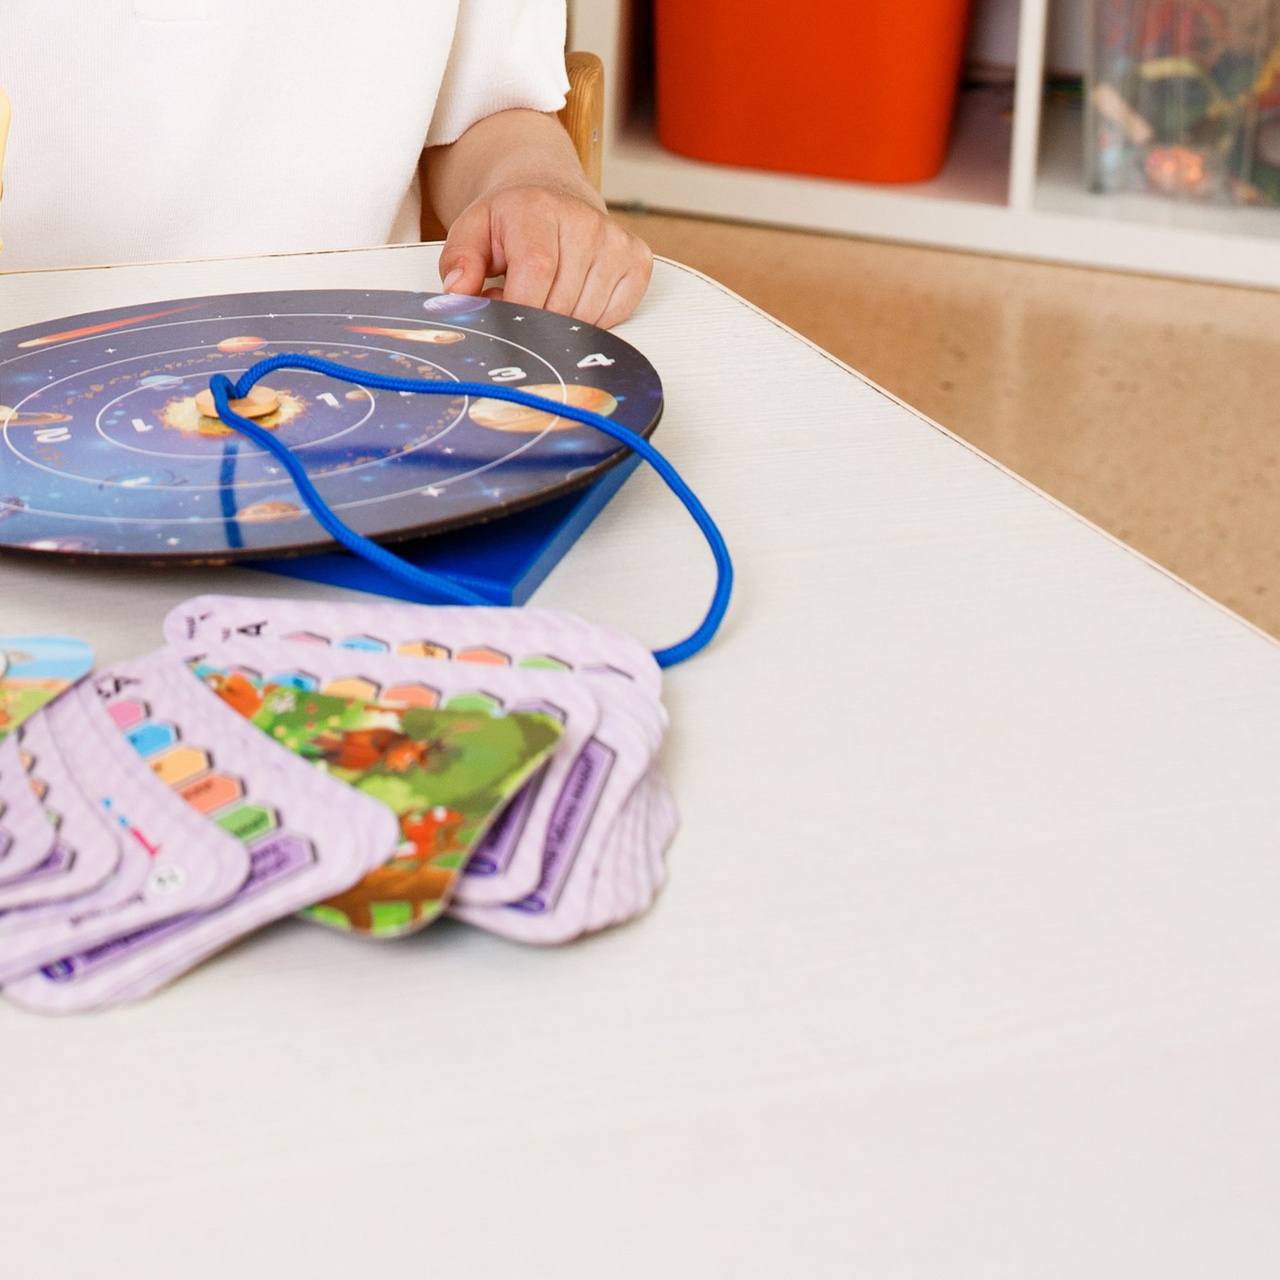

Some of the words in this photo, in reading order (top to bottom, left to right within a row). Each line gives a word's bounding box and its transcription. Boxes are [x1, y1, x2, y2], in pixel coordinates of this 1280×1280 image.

[316, 391, 344, 408] 1
[487, 366, 528, 383] 3
[576, 352, 616, 370] 4
[33, 427, 72, 443] 2
[130, 417, 154, 434] 1
